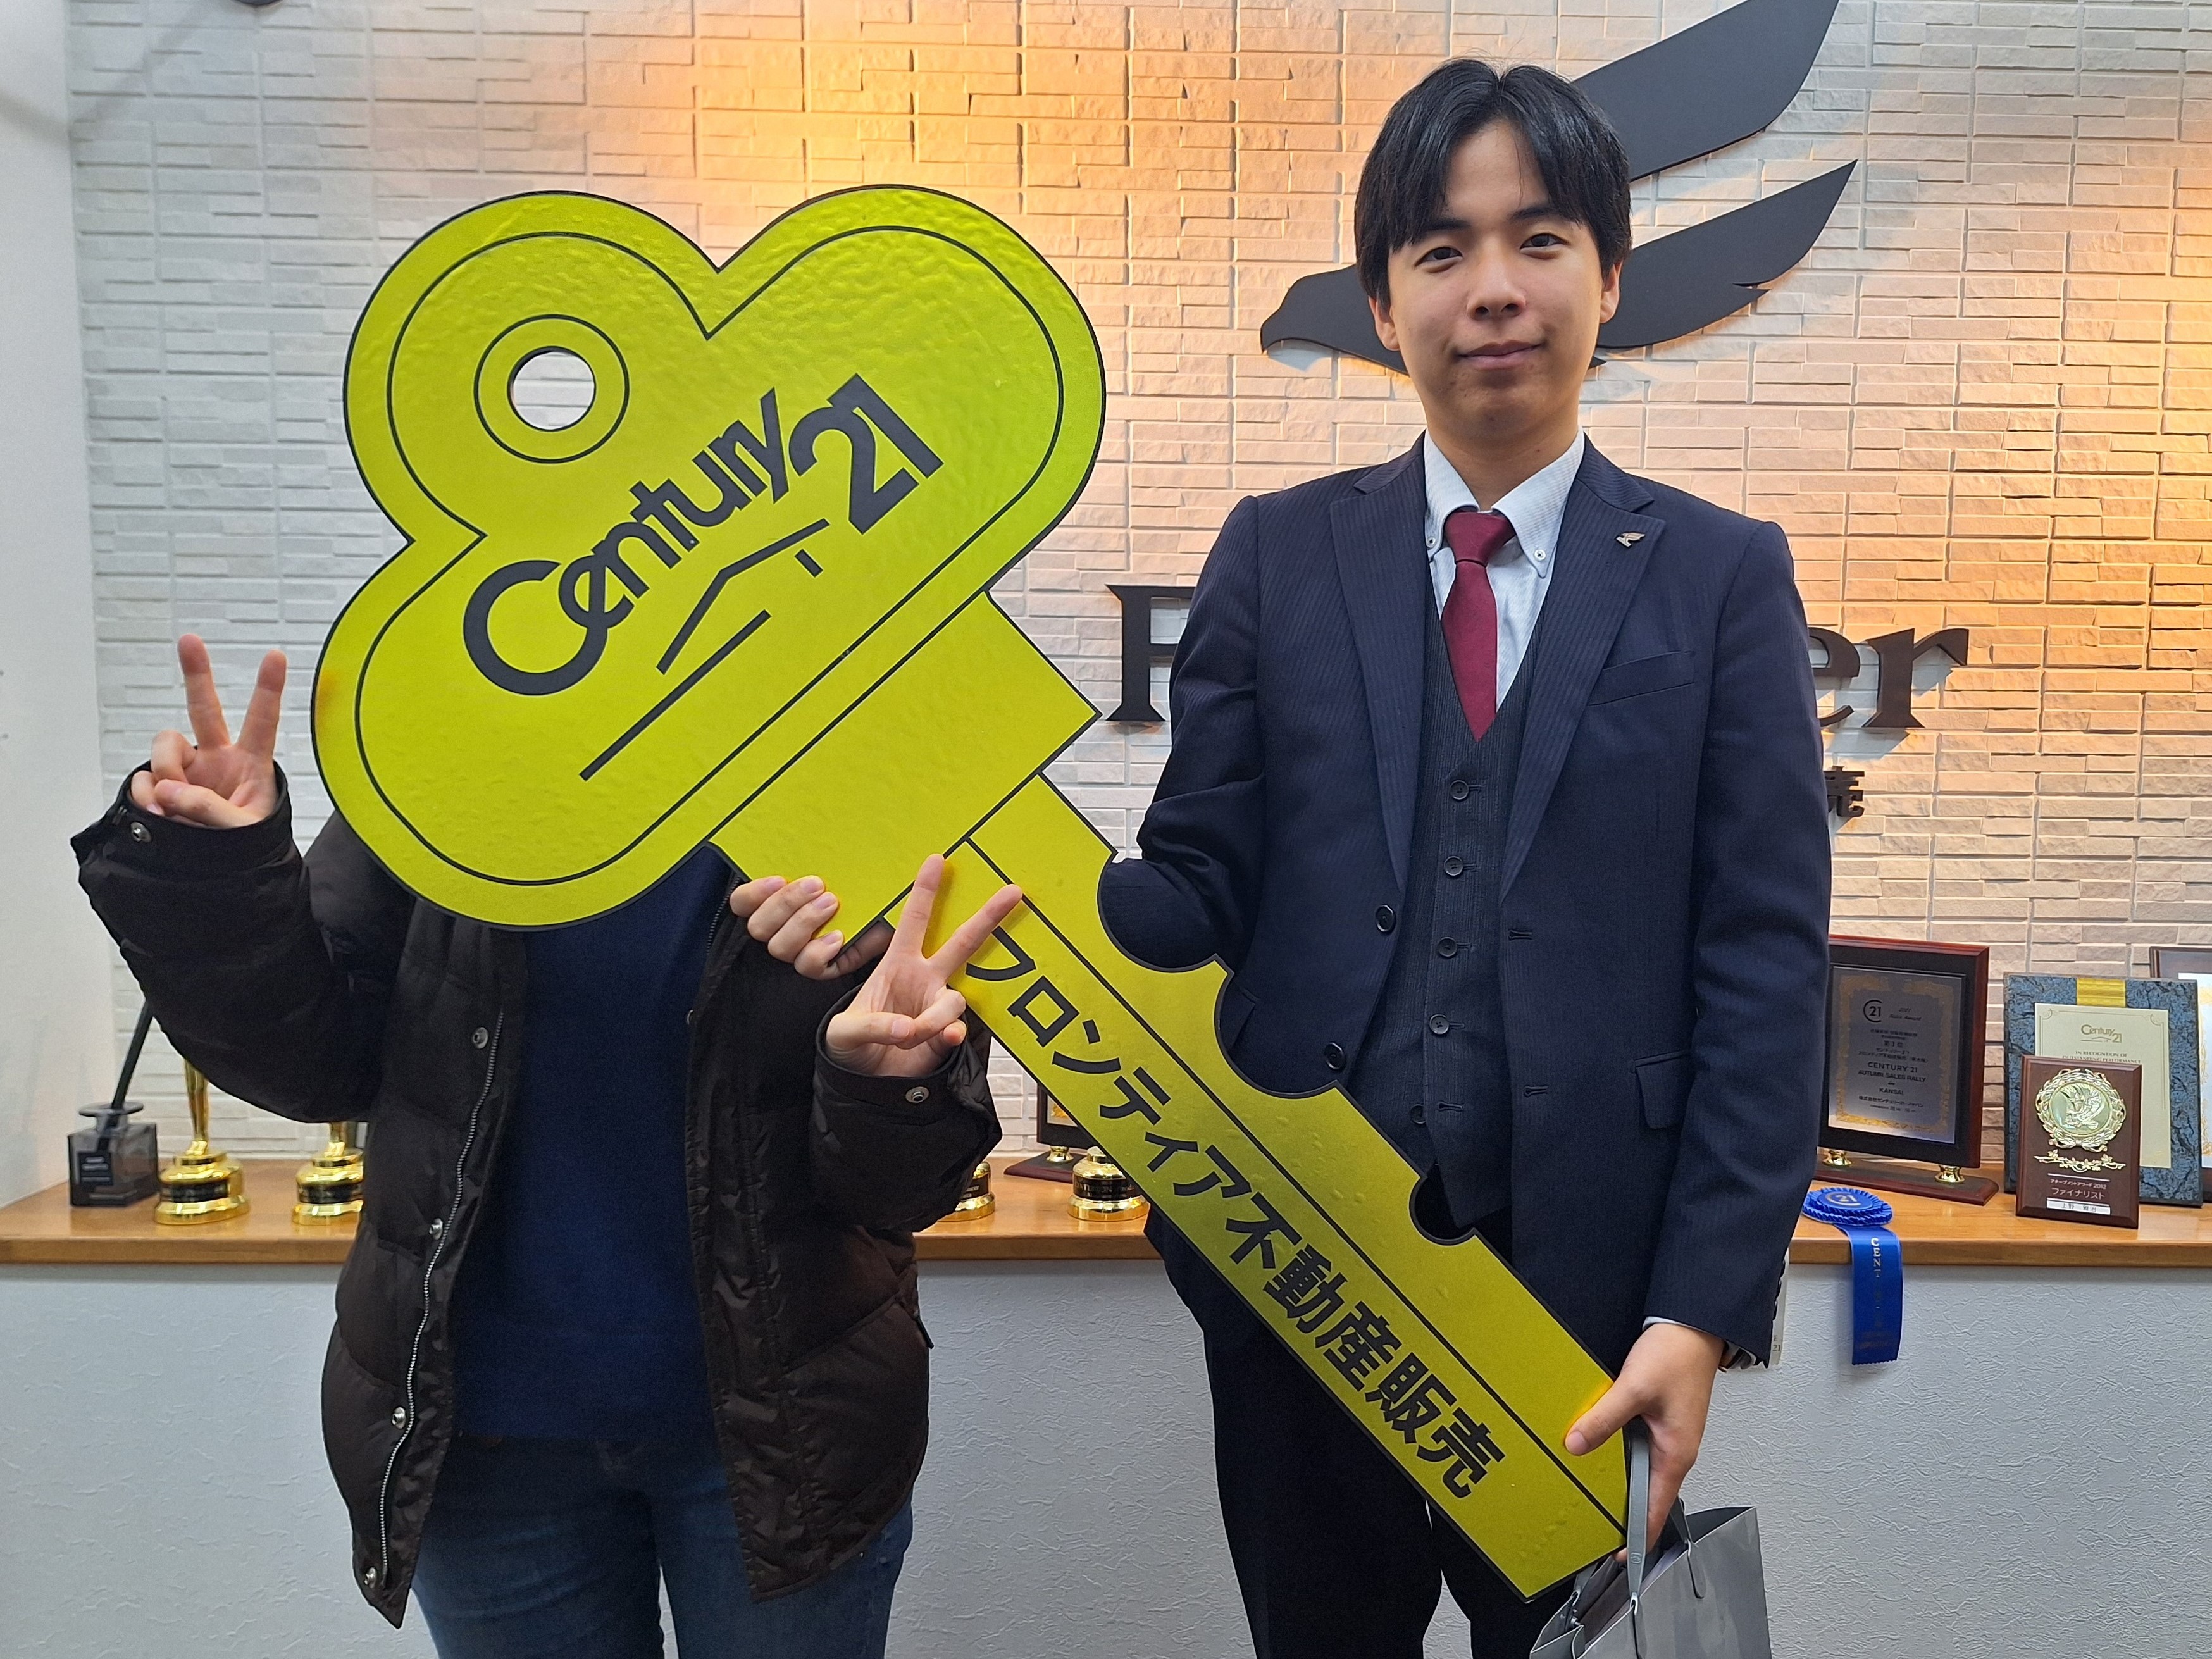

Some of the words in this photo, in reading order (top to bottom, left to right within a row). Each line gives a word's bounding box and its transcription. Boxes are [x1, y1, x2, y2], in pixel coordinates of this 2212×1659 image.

[463, 387, 789, 696] Century
[788, 373, 944, 535] 21
[2081, 1024, 2115, 1036] Century
[2111, 1033, 2122, 1043] 21
[1868, 1062, 1908, 1072] CENTURY
[2051, 1187, 2105, 1200] ファイナリスト
[966, 926, 1505, 1498] フロンティア不動産販売
